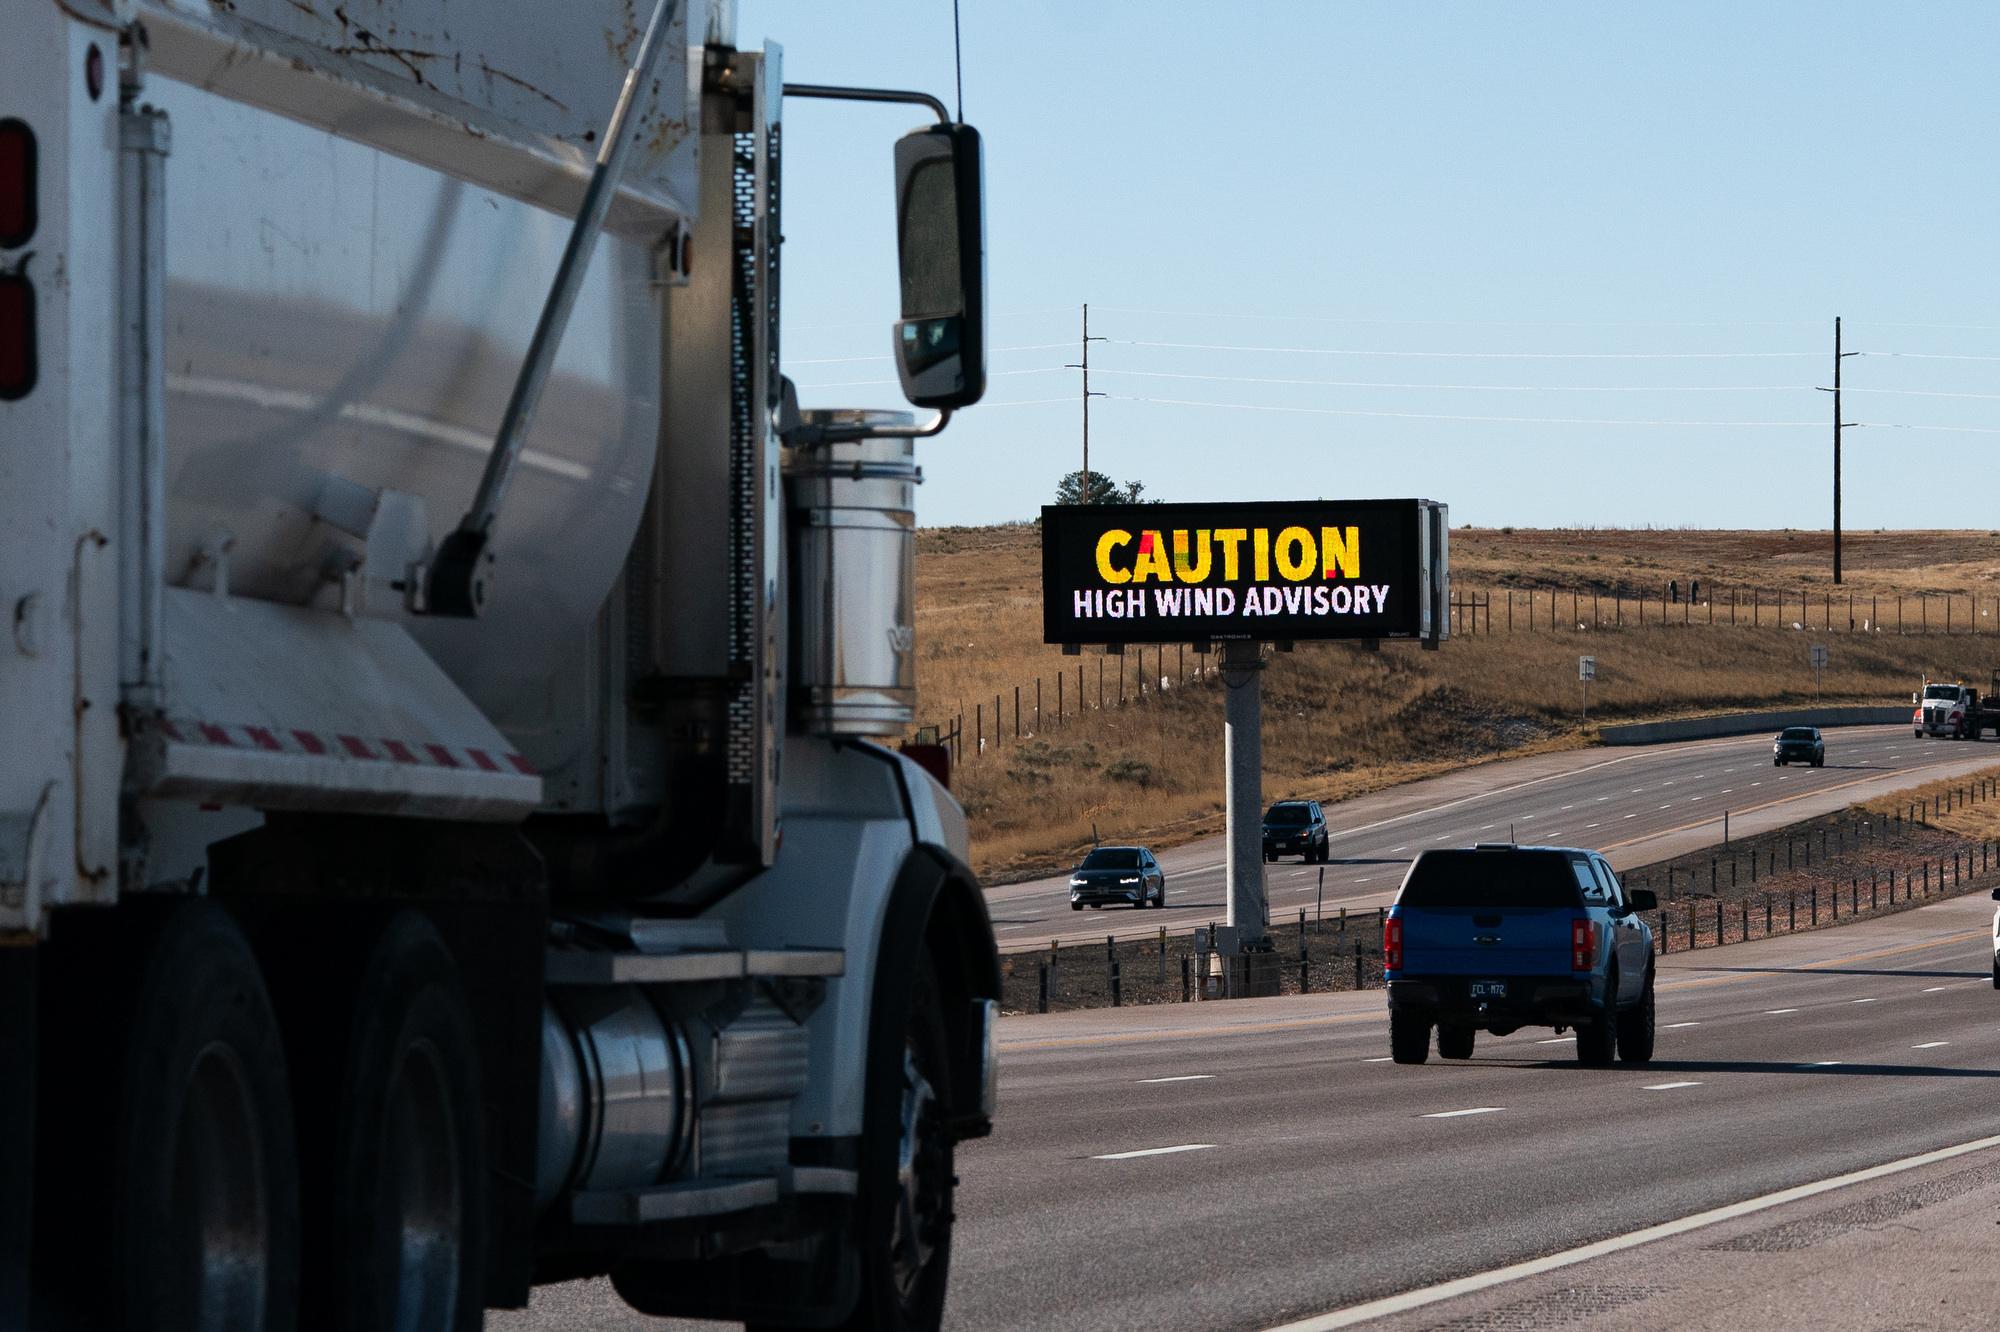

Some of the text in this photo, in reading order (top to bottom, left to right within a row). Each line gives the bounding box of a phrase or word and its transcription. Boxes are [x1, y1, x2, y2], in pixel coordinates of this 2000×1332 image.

[1095, 526, 1361, 583] CAUTION
[1074, 585, 1390, 618] HIGH WIND ADVISORY
